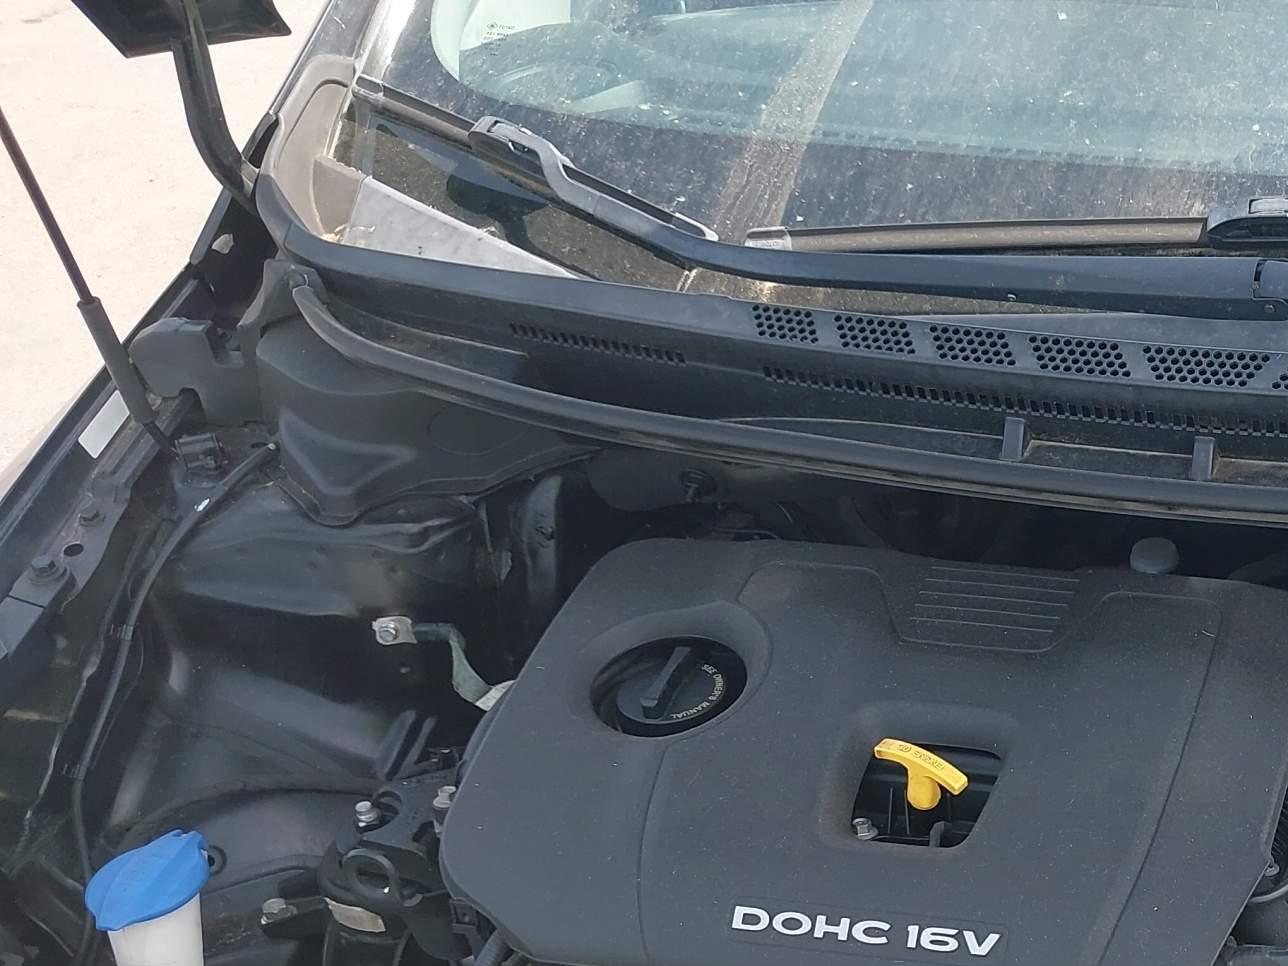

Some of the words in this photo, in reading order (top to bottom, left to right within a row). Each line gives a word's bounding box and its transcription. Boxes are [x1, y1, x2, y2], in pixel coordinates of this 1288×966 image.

[701, 663, 718, 675] SEE
[709, 673, 724, 701] OWNER'S
[670, 701, 712, 720] MANUAL
[731, 904, 889, 945] DOHC
[905, 923, 1001, 957] 16V
